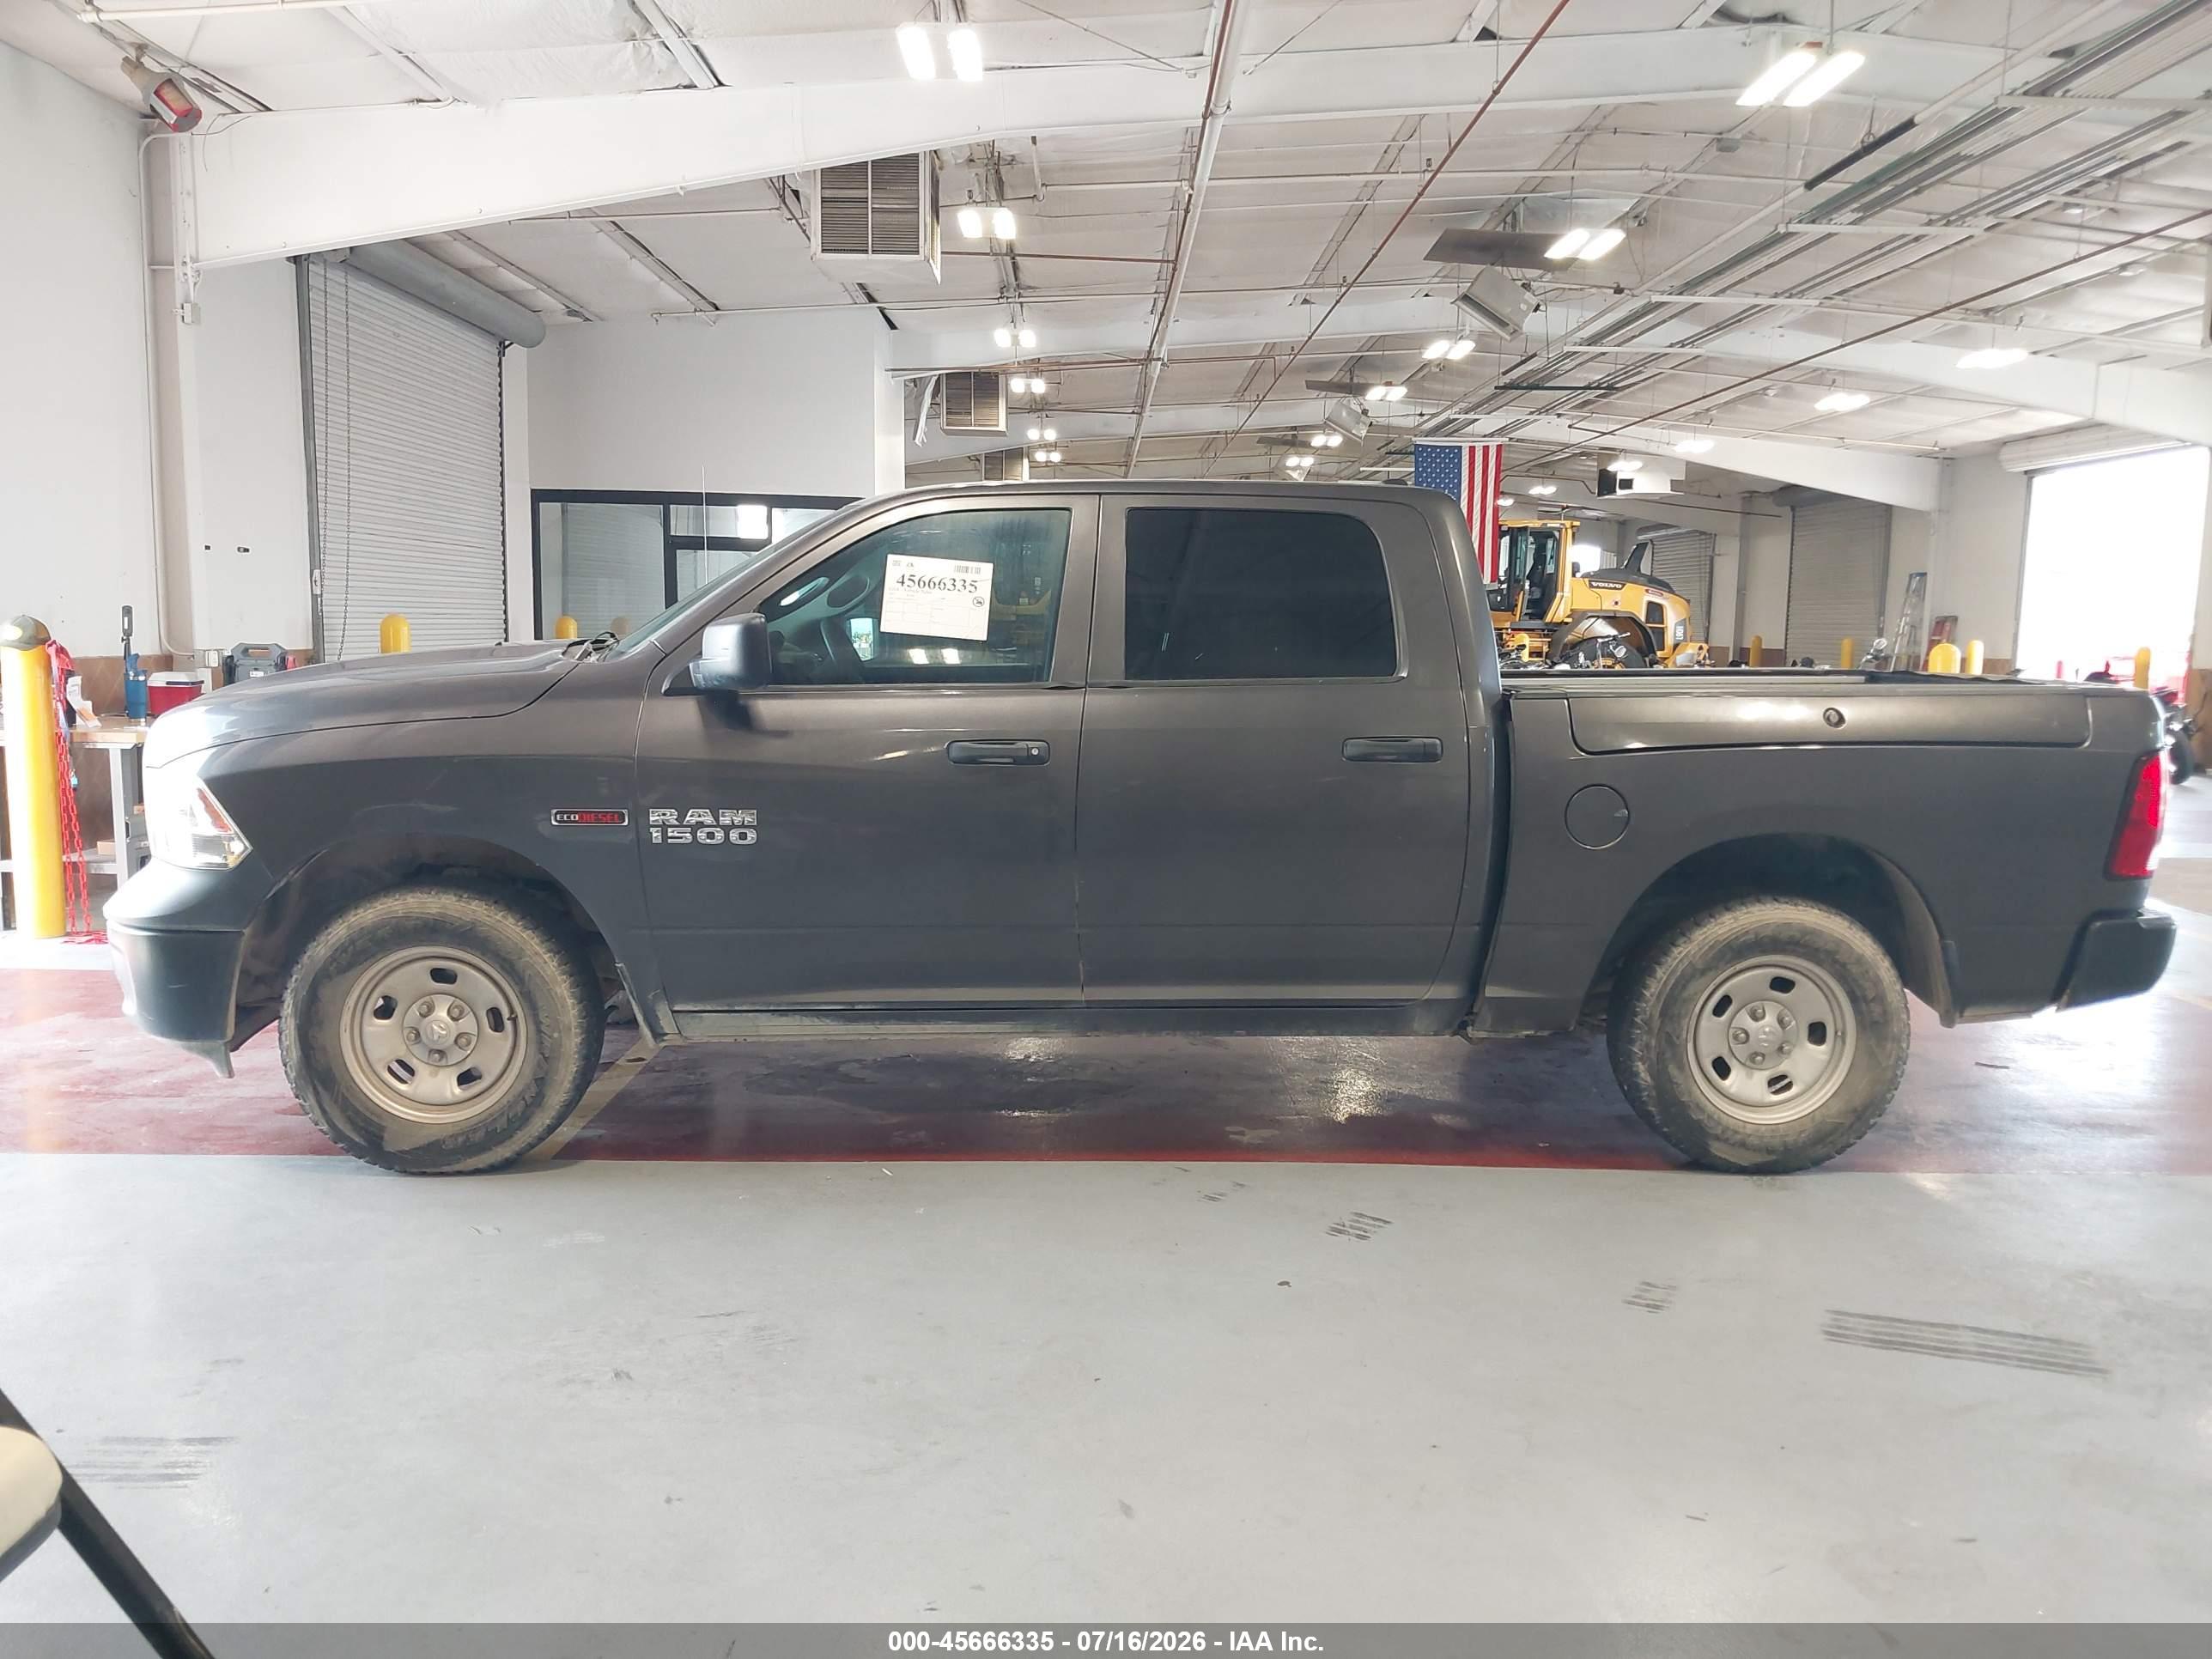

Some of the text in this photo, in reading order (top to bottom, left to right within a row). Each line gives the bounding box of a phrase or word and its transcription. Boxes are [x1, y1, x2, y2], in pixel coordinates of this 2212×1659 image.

[896, 573, 978, 593] 45666335
[649, 808, 757, 826] RAM
[649, 827, 757, 845] 1500
